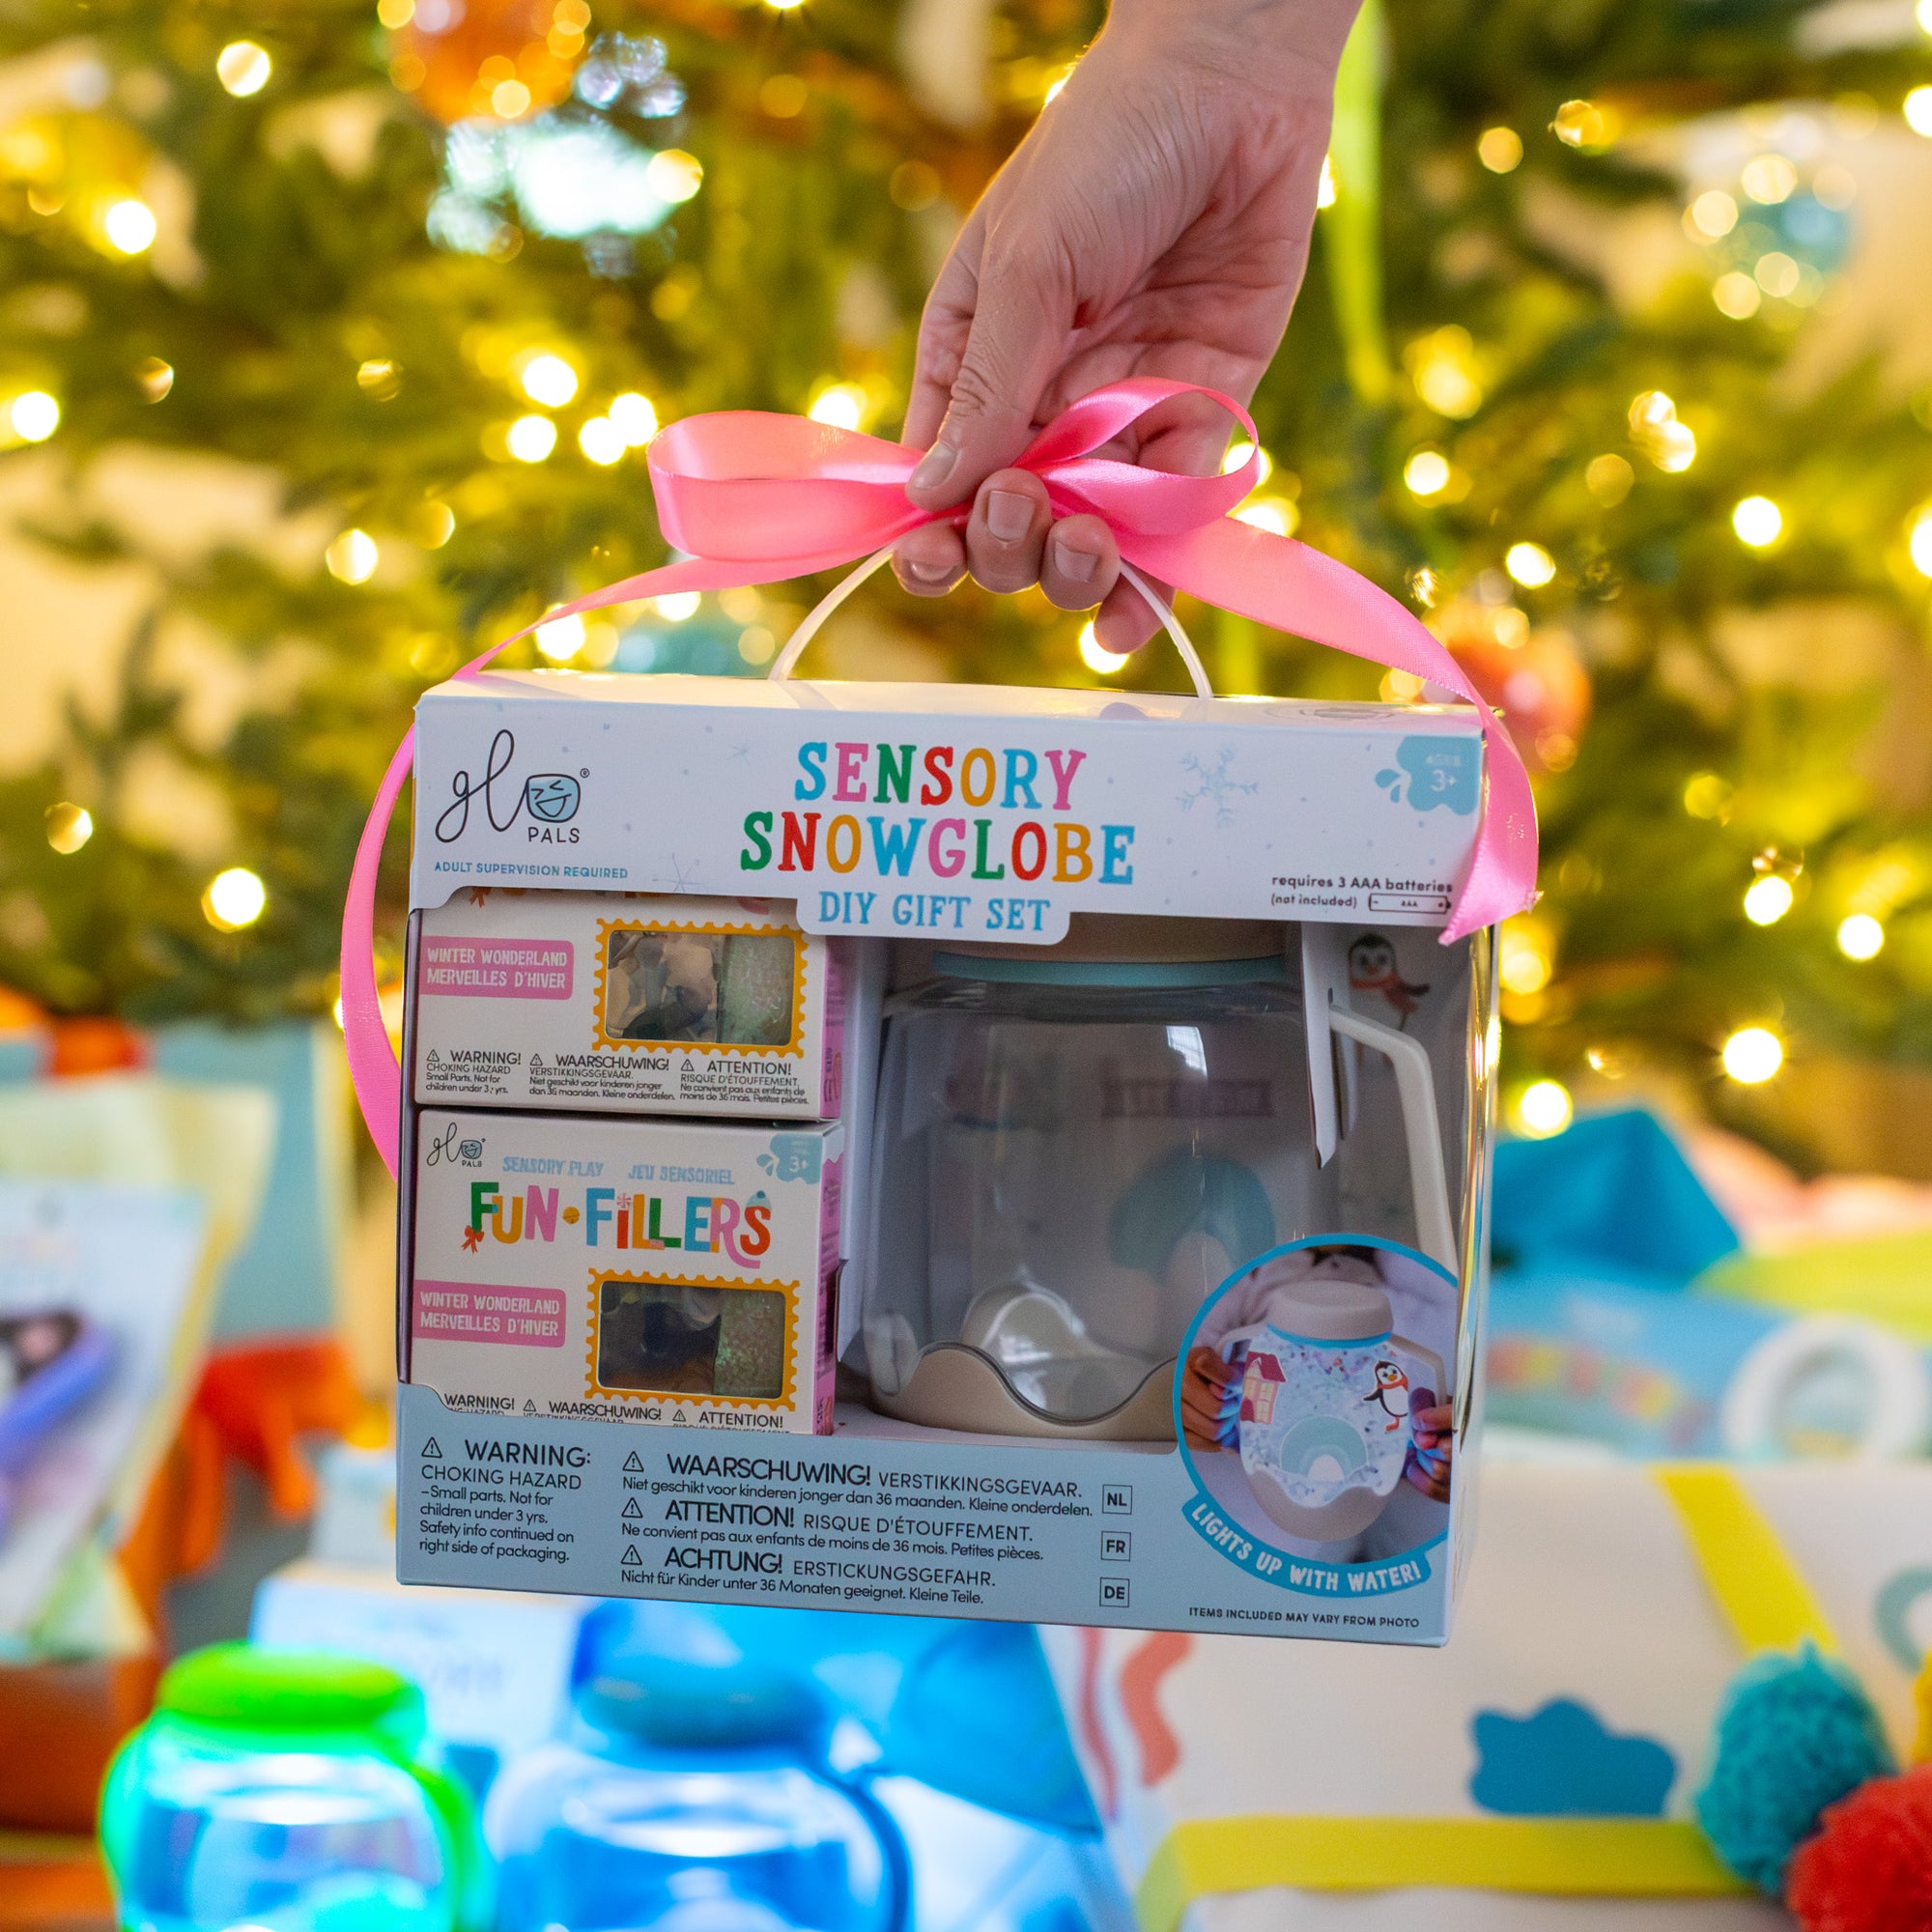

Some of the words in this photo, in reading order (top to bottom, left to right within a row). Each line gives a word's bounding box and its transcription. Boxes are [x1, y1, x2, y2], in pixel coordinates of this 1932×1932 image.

[794, 741, 1088, 810] SENSORY
[1430, 769, 1458, 792] 3+
[527, 826, 581, 844] PALS
[740, 810, 1135, 885] SNOWGLOBE
[434, 862, 472, 873] ADULT
[475, 863, 561, 877] SUPERVISION
[563, 866, 629, 879] REQUIRED
[1271, 874, 1334, 890] requires
[1338, 876, 1347, 889] 3
[1350, 877, 1381, 890] AAA
[1385, 878, 1453, 893] batteries
[818, 891, 877, 924] DIY
[892, 894, 972, 928] GIFT
[985, 898, 1051, 931] SET
[1270, 893, 1296, 907] (not
[1298, 894, 1358, 909] included)
[427, 948, 476, 964] WINTER
[480, 950, 568, 967] WONDERLAND
[426, 968, 507, 987] MERVEILLES
[514, 972, 566, 989] D'HIVER
[450, 1049, 522, 1065] WARNING!
[555, 1054, 669, 1070] WAARSCHUWING!
[706, 1060, 792, 1075] ATTENTION!
[426, 1063, 470, 1073] CHOKING
[472, 1065, 511, 1074] HAZARD
[426, 1072, 449, 1082] Small
[473, 1074, 488, 1083] Not
[529, 1066, 634, 1079] VERSTIKKINGSGEVAAR.
[680, 1073, 716, 1084] RISQUE
[426, 1082, 458, 1092] children
[459, 1084, 483, 1093] under
[501, 1155, 567, 1177] SENSORY
[566, 1159, 604, 1178] PLAY
[628, 1163, 656, 1180] JEU
[660, 1165, 736, 1185] SENSORIEL
[419, 1292, 469, 1310] WINTER
[473, 1294, 560, 1316] WONDERLAND
[420, 1311, 500, 1333] MERVEILLES
[507, 1318, 558, 1337] D'HIVER
[443, 1393, 515, 1410] WARNING!
[549, 1401, 662, 1421] WAARSCHUWING!
[698, 1410, 783, 1429] ATTENTION!
[464, 1438, 591, 1468] WARNING:
[420, 1464, 504, 1485] CHOKING
[509, 1470, 582, 1490] HAZARD
[666, 1452, 872, 1487] WAARSCHUWING!
[878, 1470, 1083, 1498] VERSTIKKINGSGEVAAR.
[469, 1490, 507, 1508] parts.
[509, 1491, 532, 1504] Not
[533, 1492, 554, 1506] for
[622, 1476, 649, 1491] Niet
[651, 1479, 706, 1495] geschikt
[707, 1485, 737, 1496] voor
[739, 1483, 797, 1500] kinderen
[798, 1488, 844, 1506] jonger
[845, 1491, 873, 1505] dan
[875, 1492, 893, 1506] 36
[895, 1492, 966, 1511] maanden.
[968, 1497, 1009, 1513] Kleine
[1010, 1500, 1094, 1518] onderdelen.
[1105, 1492, 1128, 1508] NL
[419, 1503, 472, 1518] children
[474, 1506, 514, 1521] under
[515, 1509, 524, 1522] 3
[526, 1512, 549, 1526] yrs.
[665, 1498, 796, 1528] ATTENTION!
[803, 1513, 871, 1534] RISQUE
[876, 1515, 1034, 1543] D'ÉTOUFFEMENT.
[419, 1520, 461, 1539] Safety
[463, 1522, 488, 1537] info
[489, 1526, 554, 1543] continued
[556, 1531, 575, 1544] on
[621, 1521, 641, 1537] Ne
[642, 1525, 698, 1541] convient
[700, 1530, 726, 1545] pas
[727, 1531, 753, 1545] aux
[754, 1532, 806, 1548] enfants
[808, 1534, 827, 1548] de
[828, 1536, 869, 1550] moins
[871, 1538, 891, 1552] de
[893, 1540, 910, 1553] 36
[912, 1542, 949, 1556] mois.
[951, 1542, 995, 1558] Petites
[996, 1545, 1044, 1563] pièces.
[419, 1537, 449, 1555] right
[451, 1539, 479, 1554] side
[480, 1542, 496, 1556] of
[496, 1545, 571, 1565] packaging.
[1105, 1539, 1126, 1554] FR
[1190, 1502, 1254, 1561] LIGHTS
[1255, 1551, 1283, 1577] UP
[1289, 1563, 1339, 1592] WITH
[1346, 1559, 1422, 1593] WATER!
[664, 1546, 784, 1576] ACHTUNG!
[793, 1560, 997, 1588] ERSTICKUNGSGEFAHR.
[621, 1569, 655, 1585] Nicht
[656, 1571, 677, 1586] für
[678, 1574, 722, 1589] Kinder
[723, 1577, 759, 1591] unter
[759, 1578, 777, 1592] 36
[779, 1579, 841, 1597] Monaten
[842, 1586, 907, 1602] geeignet.
[909, 1587, 950, 1603] Kleine
[952, 1589, 984, 1605] Teile.
[1103, 1585, 1125, 1601] DE
[1188, 1605, 1224, 1619] ITEMS
[1226, 1607, 1283, 1623] INCLUDED
[1285, 1611, 1310, 1624] MAY
[1312, 1614, 1341, 1626] VARY
[1342, 1615, 1378, 1628] FROM
[1378, 1617, 1420, 1629] PHOTO
